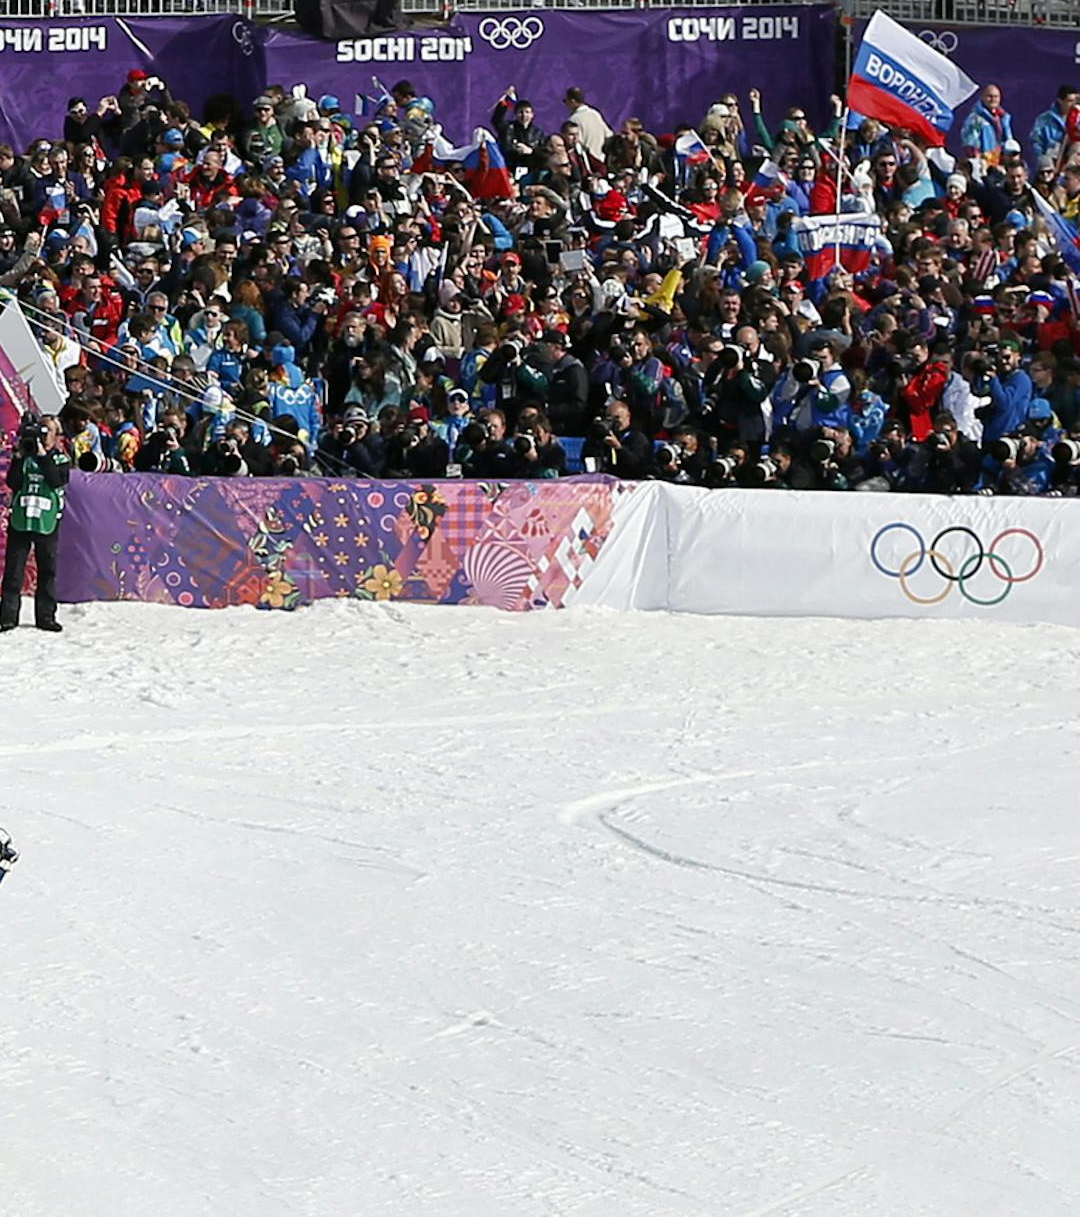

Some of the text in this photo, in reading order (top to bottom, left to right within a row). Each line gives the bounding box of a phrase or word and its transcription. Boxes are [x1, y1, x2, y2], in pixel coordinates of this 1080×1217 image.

[48, 27, 106, 51] 2014
[668, 17, 798, 41] СОЧИ 2014
[336, 37, 415, 62] SOCHI
